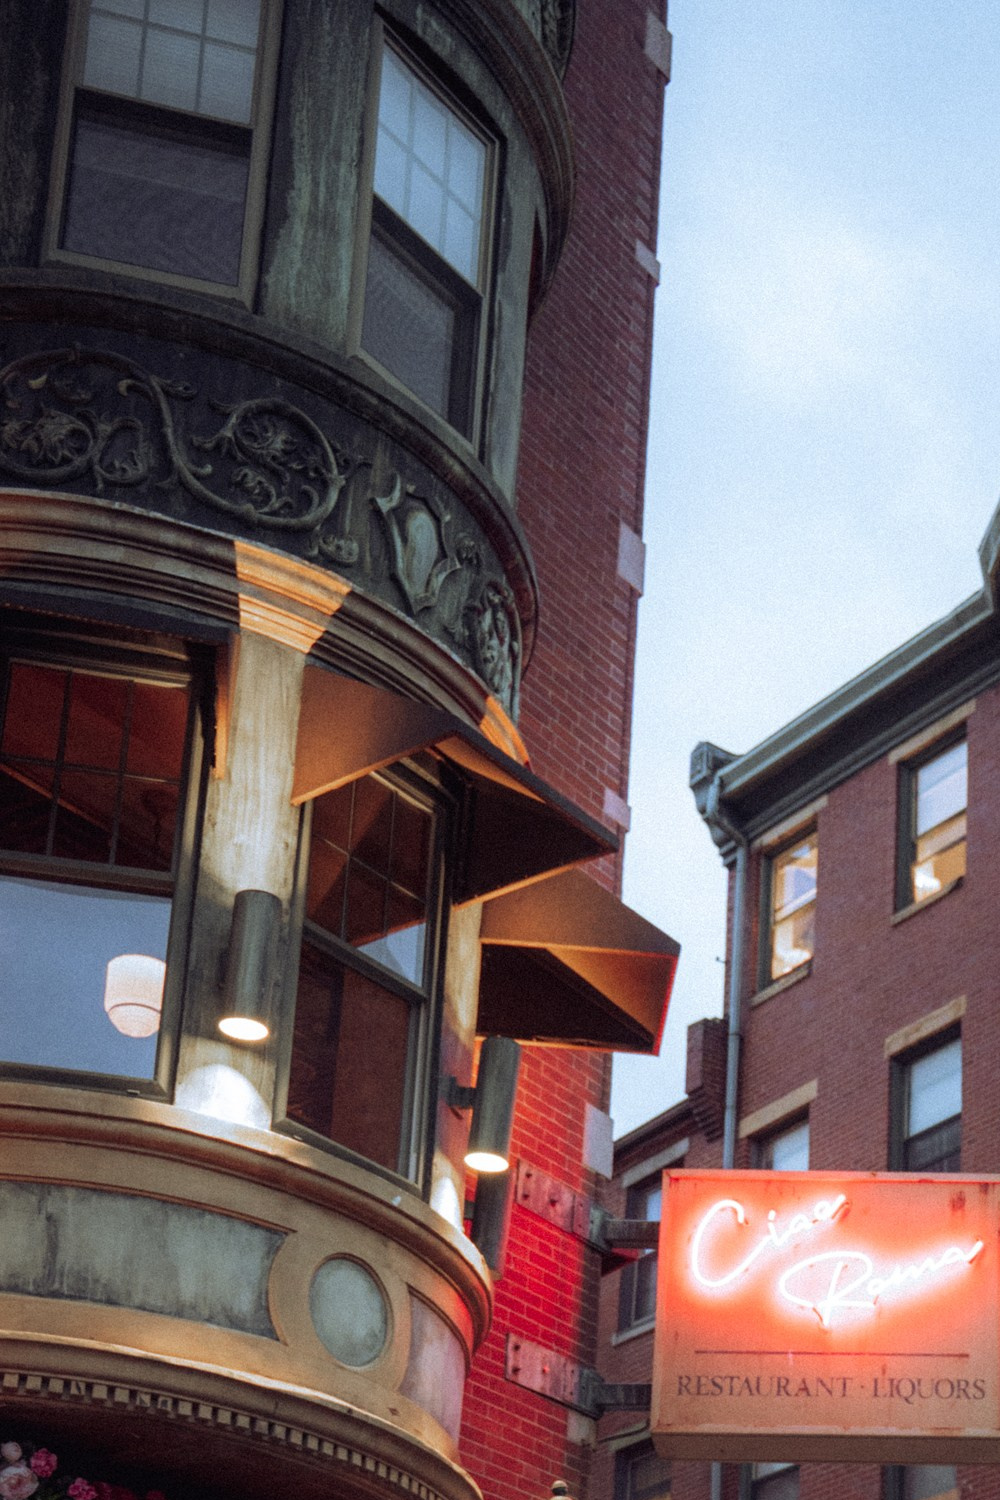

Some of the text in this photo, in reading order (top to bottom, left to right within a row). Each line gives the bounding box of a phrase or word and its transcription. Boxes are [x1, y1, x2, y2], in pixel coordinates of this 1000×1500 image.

[691, 1193, 847, 1288] Ciao
[778, 1240, 984, 1328] Roma
[676, 1375, 987, 1404] RESTAURANT LIQUORS
